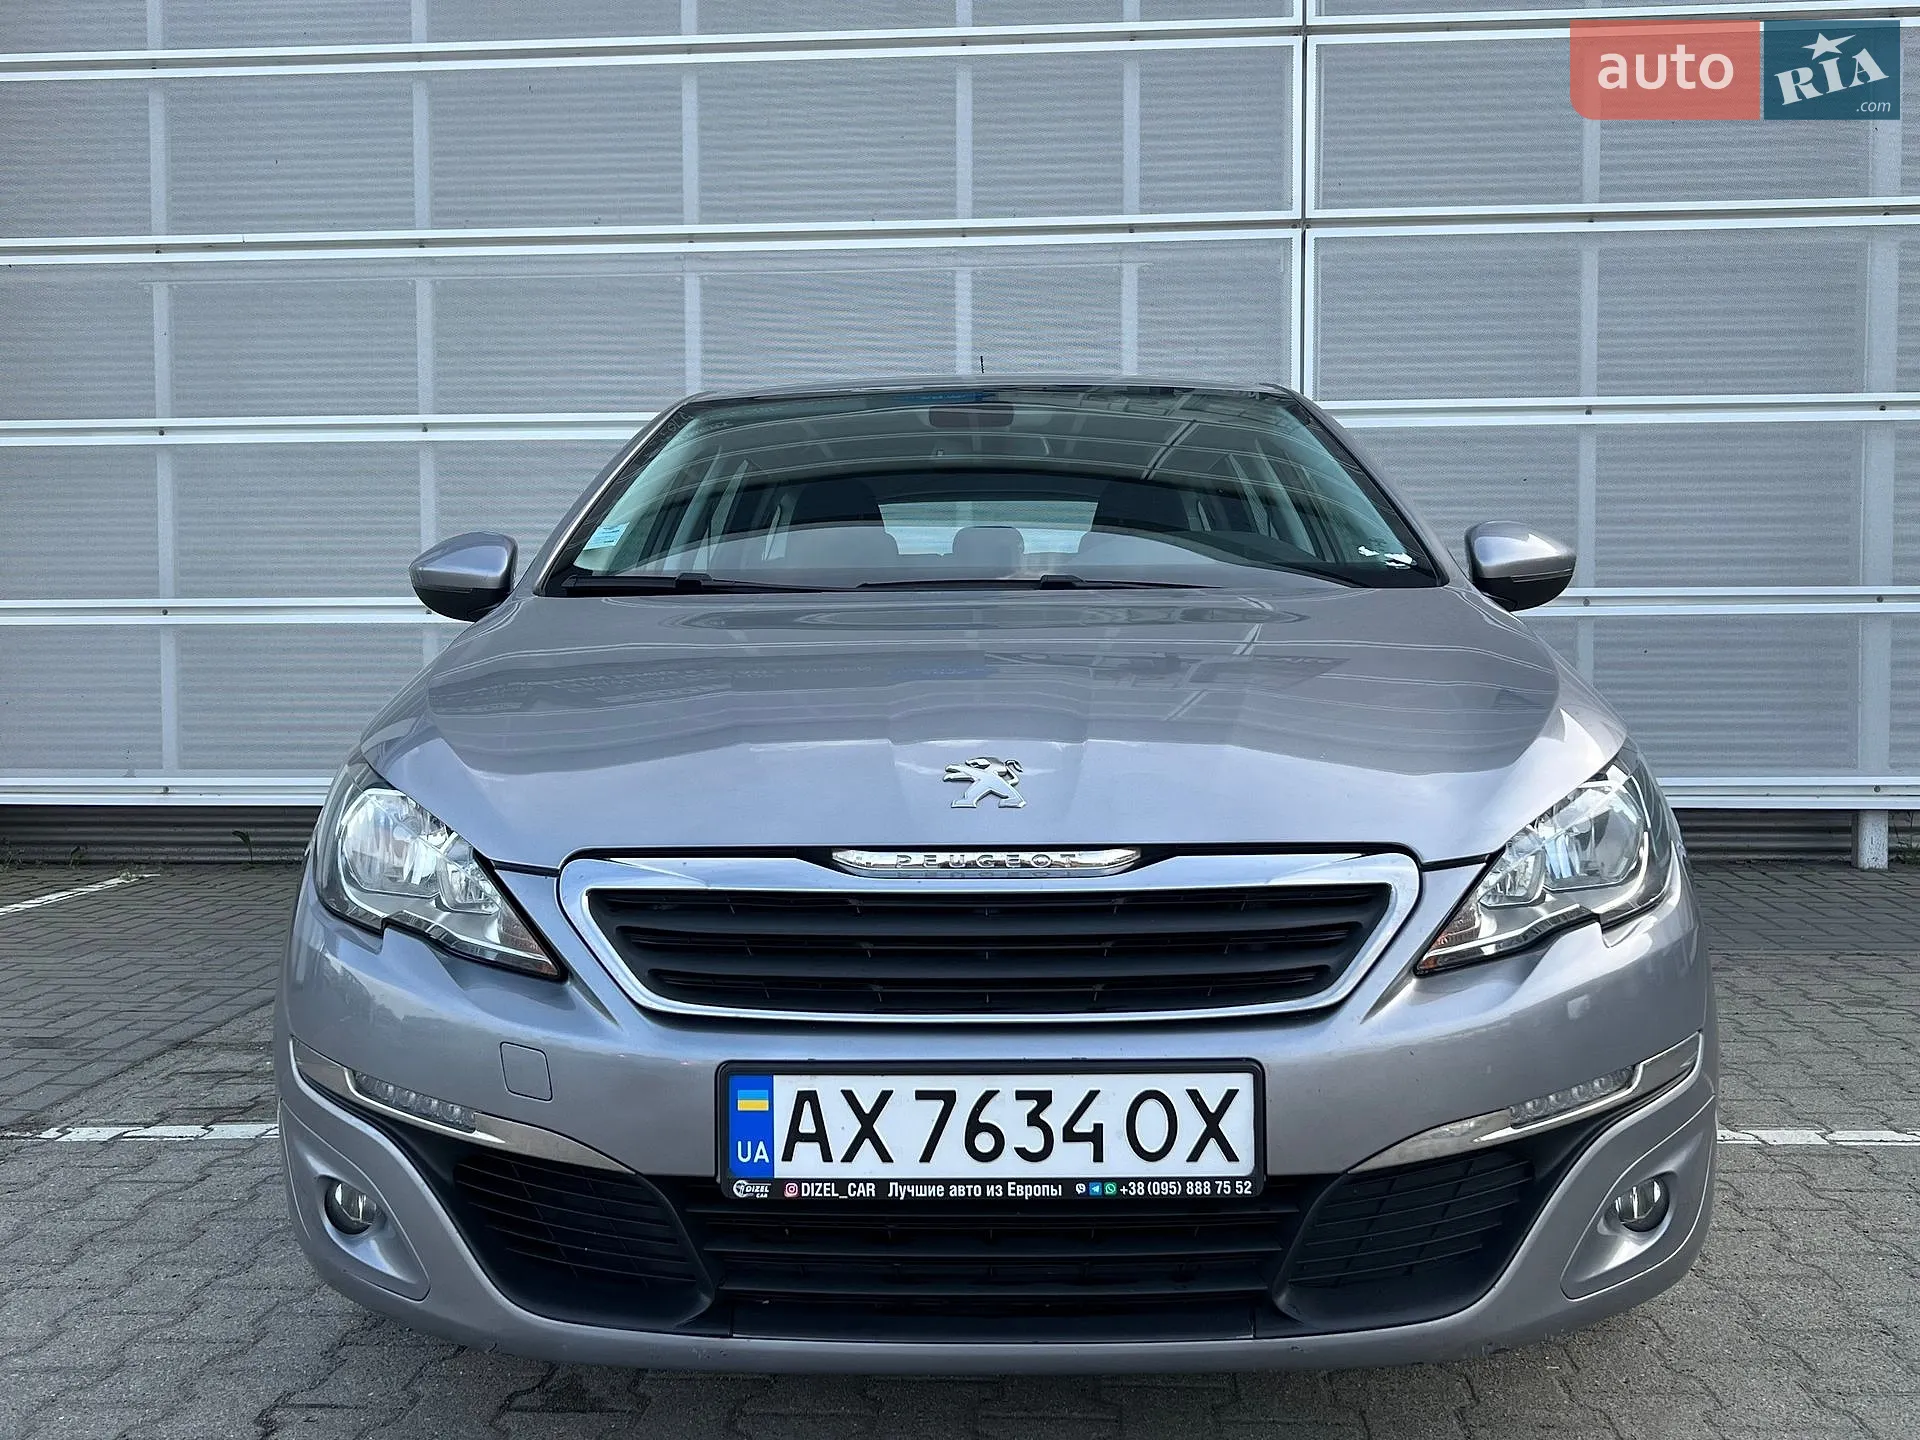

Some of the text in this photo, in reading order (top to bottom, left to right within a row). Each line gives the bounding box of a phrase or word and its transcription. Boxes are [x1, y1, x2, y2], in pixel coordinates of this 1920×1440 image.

[896, 854, 1077, 868] PEUGEOT
[781, 1088, 1240, 1163] AX 7634 OX
[737, 1140, 769, 1163] UA
[745, 1185, 770, 1193] DIZEL
[801, 1182, 876, 1199] DIZEL_CAR
[887, 1181, 1062, 1200] Лучшие авто из Европы
[1120, 1180, 1252, 1196] +38 (095) 888 75 52
